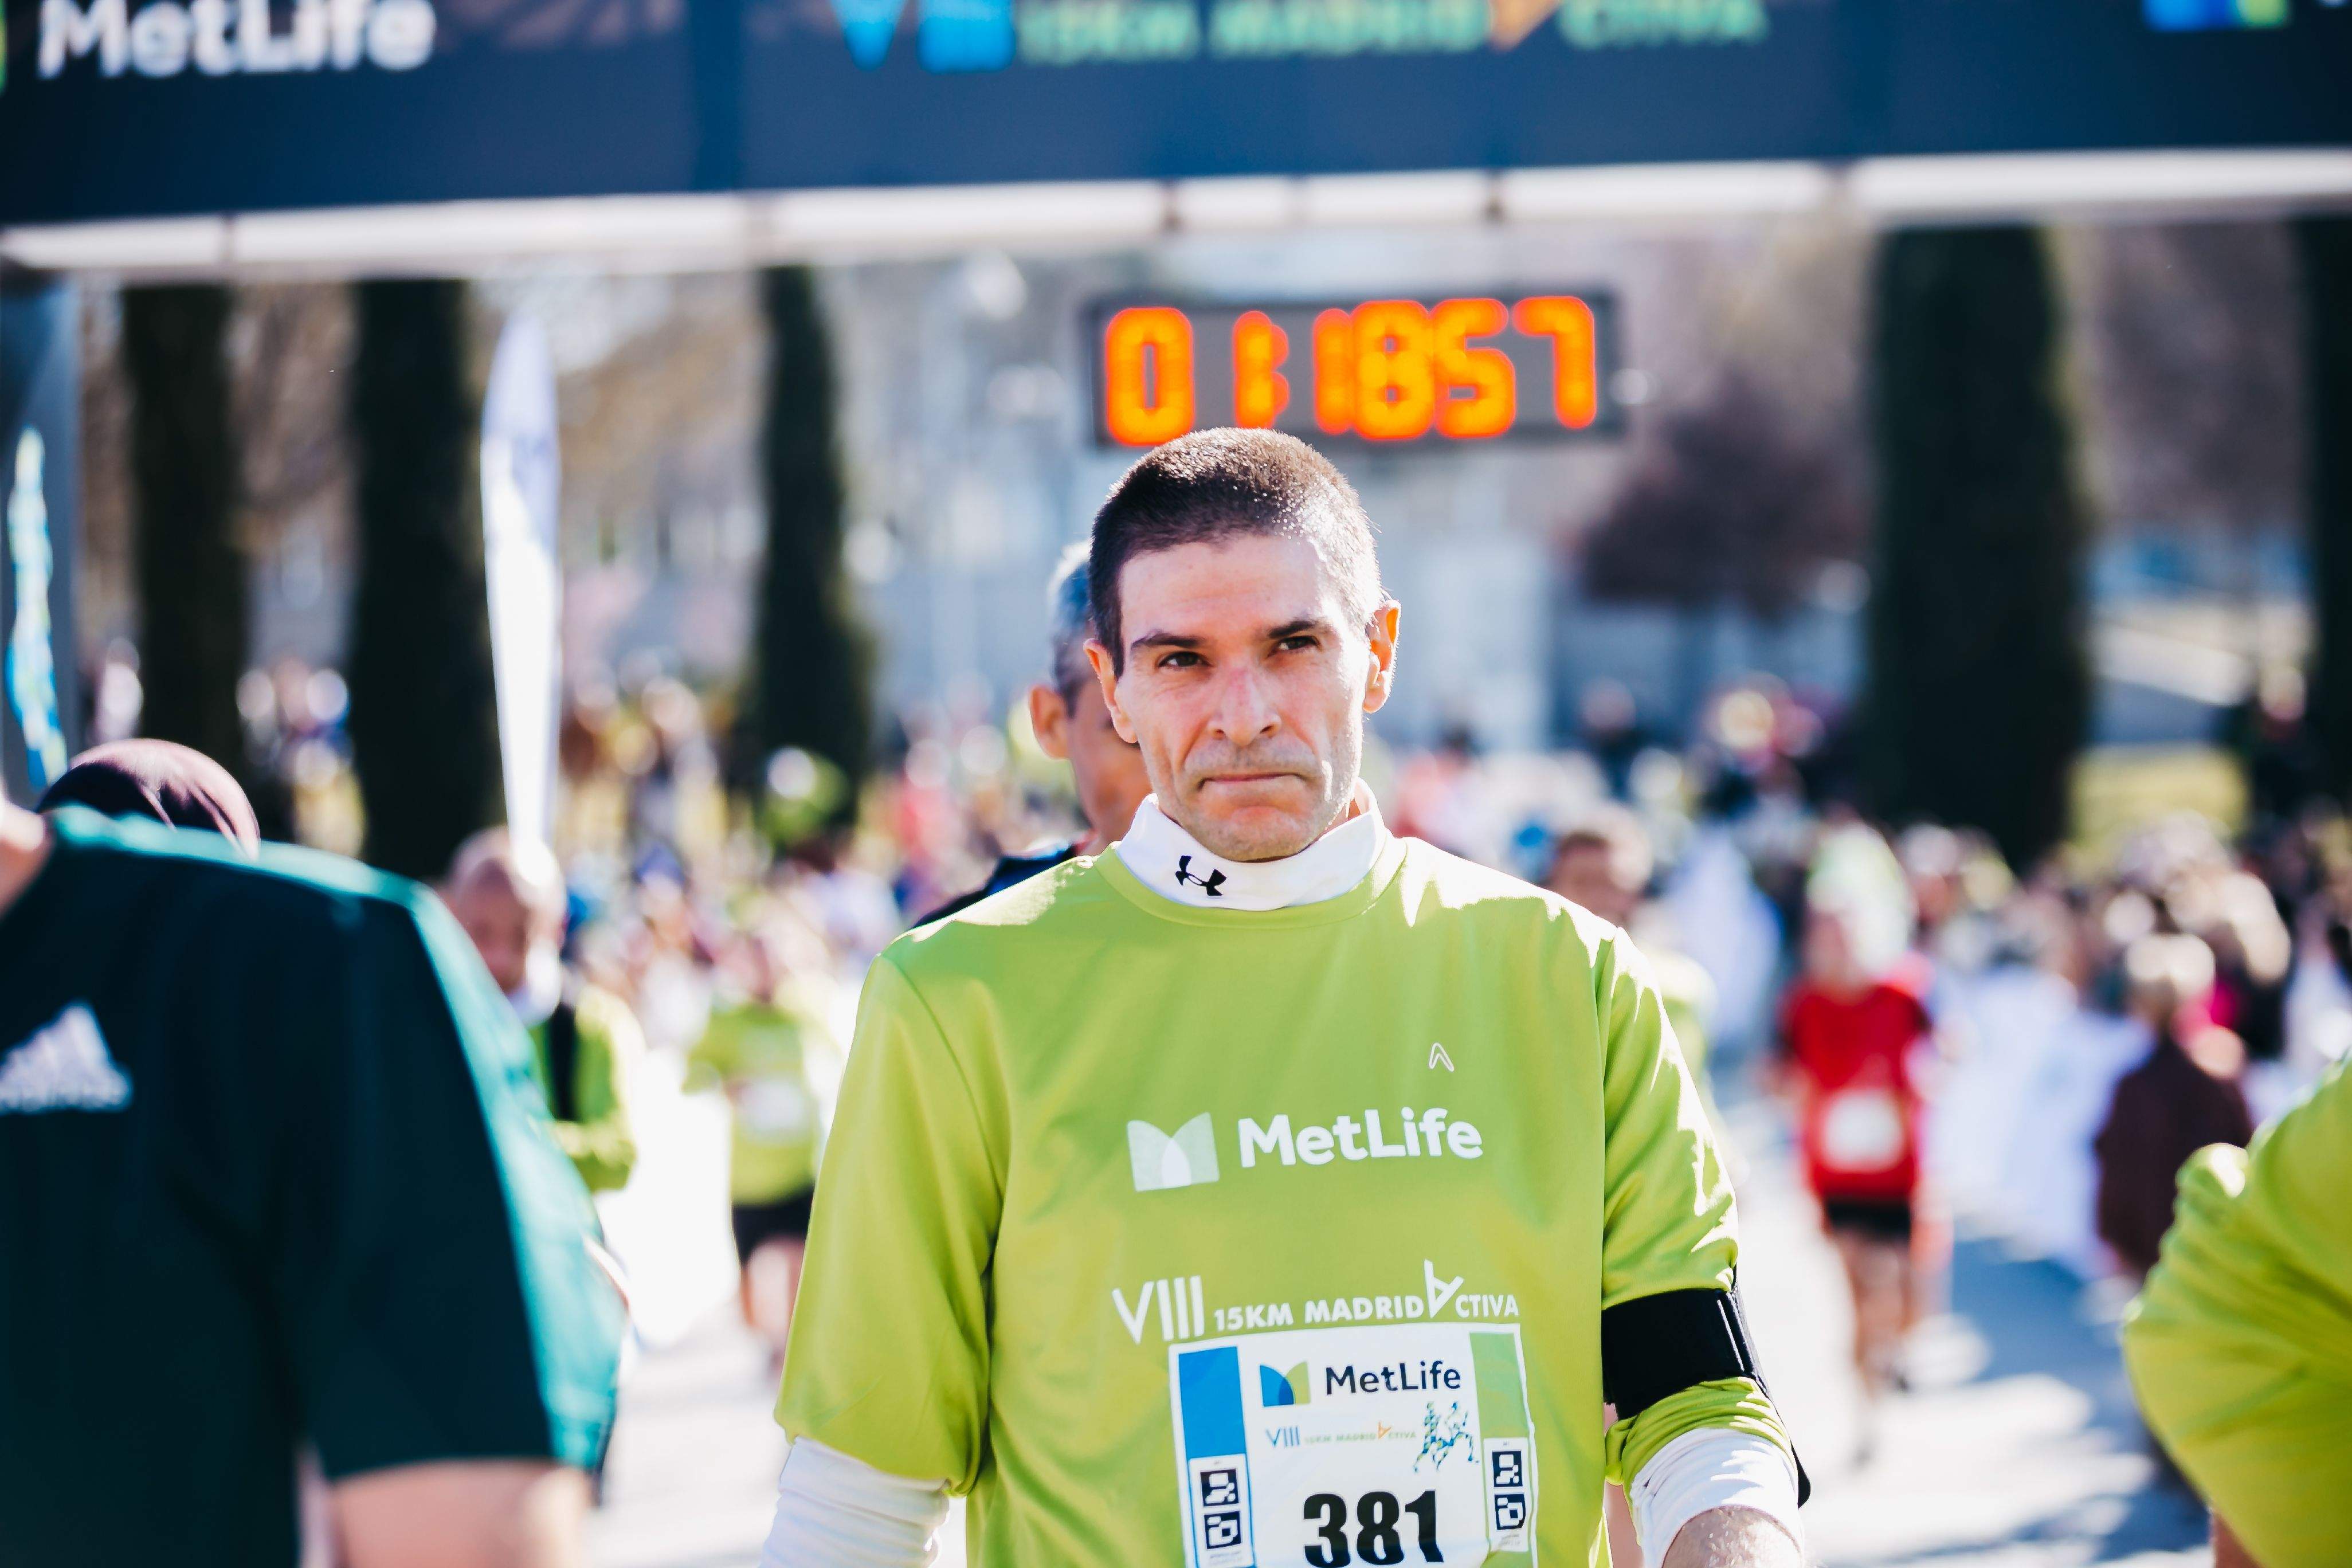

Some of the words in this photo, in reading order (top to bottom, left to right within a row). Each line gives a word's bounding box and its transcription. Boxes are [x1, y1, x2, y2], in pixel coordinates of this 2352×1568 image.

[37, 0, 438, 80] MetLife
[1239, 1107, 1483, 1167] MetLife
[1112, 1275, 1204, 1344] VIII
[1214, 1302, 1293, 1331] 15KM
[1304, 1295, 1424, 1323] MADRID
[1326, 1360, 1461, 1395] MetLife
[1265, 1425, 1301, 1448] VIII
[1303, 1489, 1444, 1567] 381
